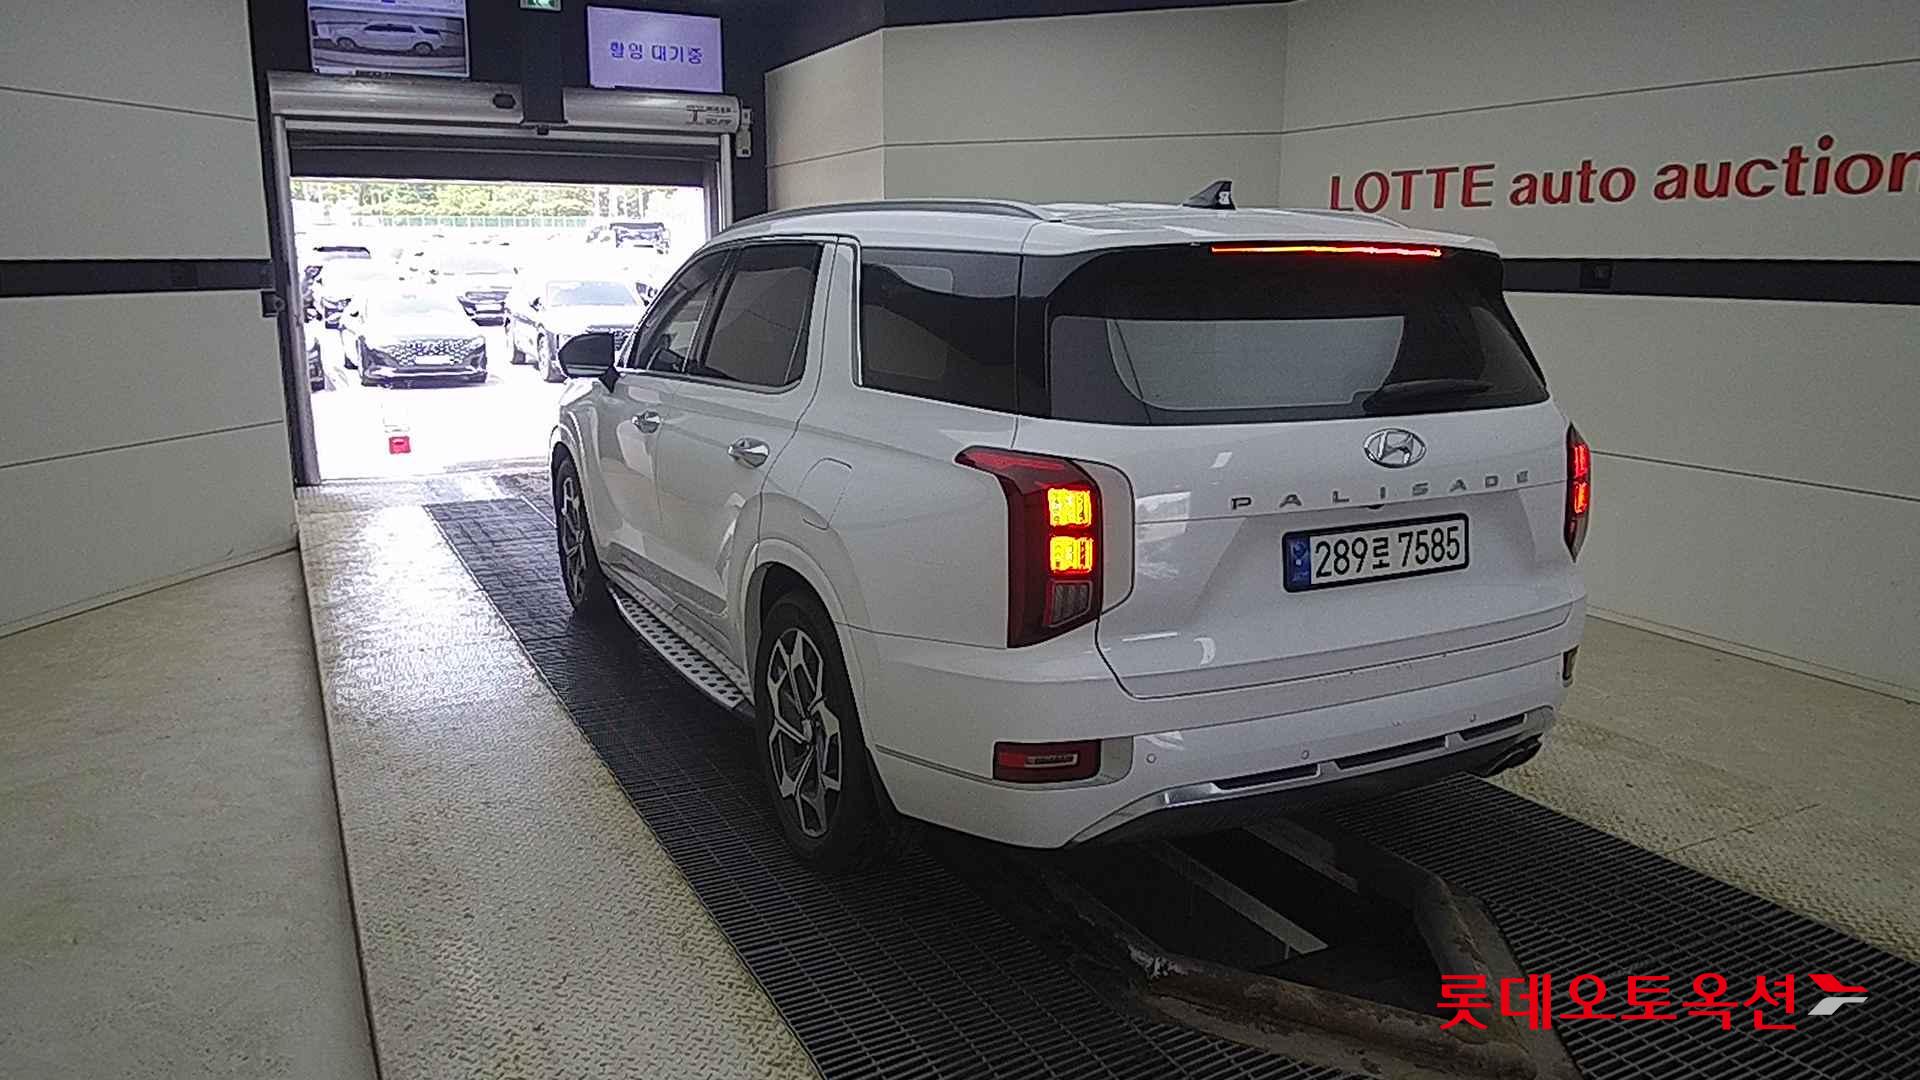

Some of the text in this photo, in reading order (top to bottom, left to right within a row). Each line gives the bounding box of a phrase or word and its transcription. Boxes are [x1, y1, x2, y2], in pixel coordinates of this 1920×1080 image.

[651, 44, 703, 65] 대기중
[1330, 163, 1496, 212] LOTTE
[1510, 160, 1636, 207] auto
[1231, 470, 1529, 510] PALISADE
[1314, 525, 1460, 579] 289로 7585
